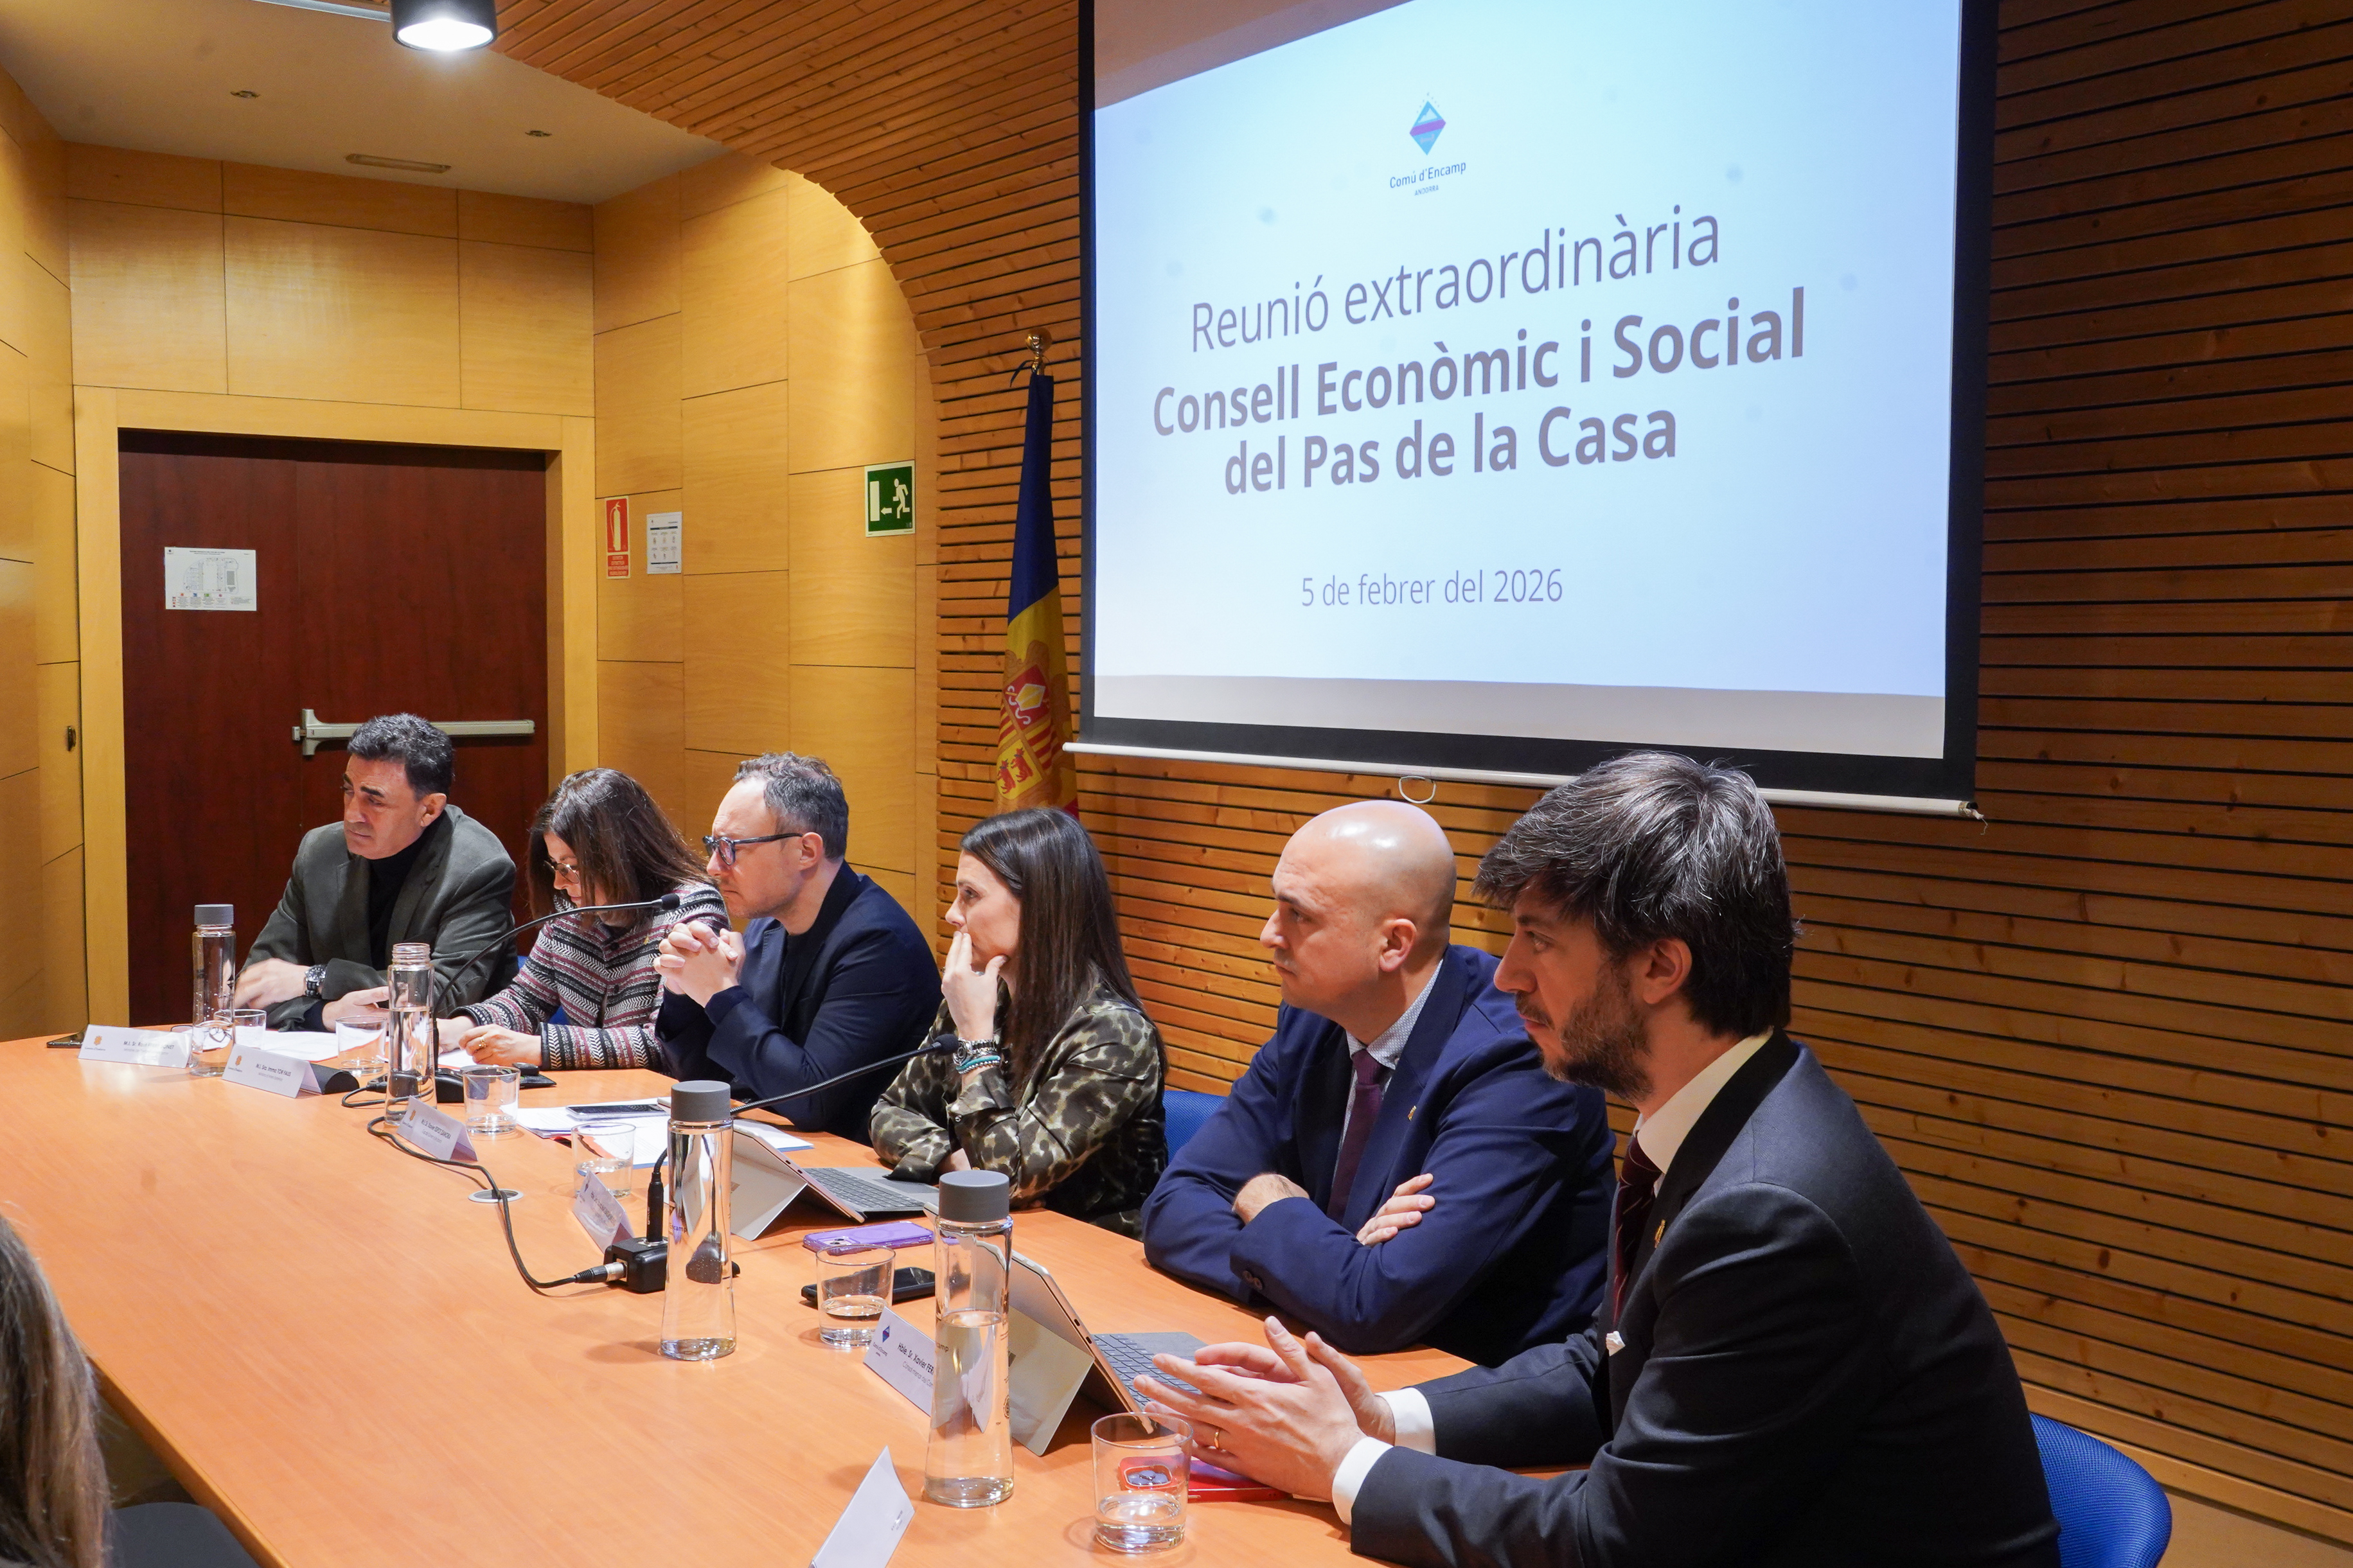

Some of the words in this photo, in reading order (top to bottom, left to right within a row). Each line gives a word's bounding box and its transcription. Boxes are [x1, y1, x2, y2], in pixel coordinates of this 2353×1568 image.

[1390, 170, 1416, 189] Comú
[1419, 162, 1466, 182] d'Encamp
[1414, 184, 1439, 196] ANDORRA
[1193, 274, 1329, 353] Reunió
[1344, 204, 1719, 325] extraordinària
[1153, 362, 1299, 437] Consell
[1317, 328, 1559, 416] Econòmic
[1580, 318, 1592, 383] i
[1612, 286, 1804, 379] Social
[1225, 435, 1286, 495] del
[1304, 435, 1380, 488] Pas
[1395, 418, 1455, 480] de
[1473, 411, 1517, 473] la
[1538, 405, 1676, 468] Casa
[1302, 577, 1314, 607] 5
[1322, 574, 1350, 606] de
[1357, 570, 1436, 605] febrer
[1444, 568, 1483, 604] del
[1493, 568, 1563, 603] 2026
[913, 1353, 927, 1369] Xavier
